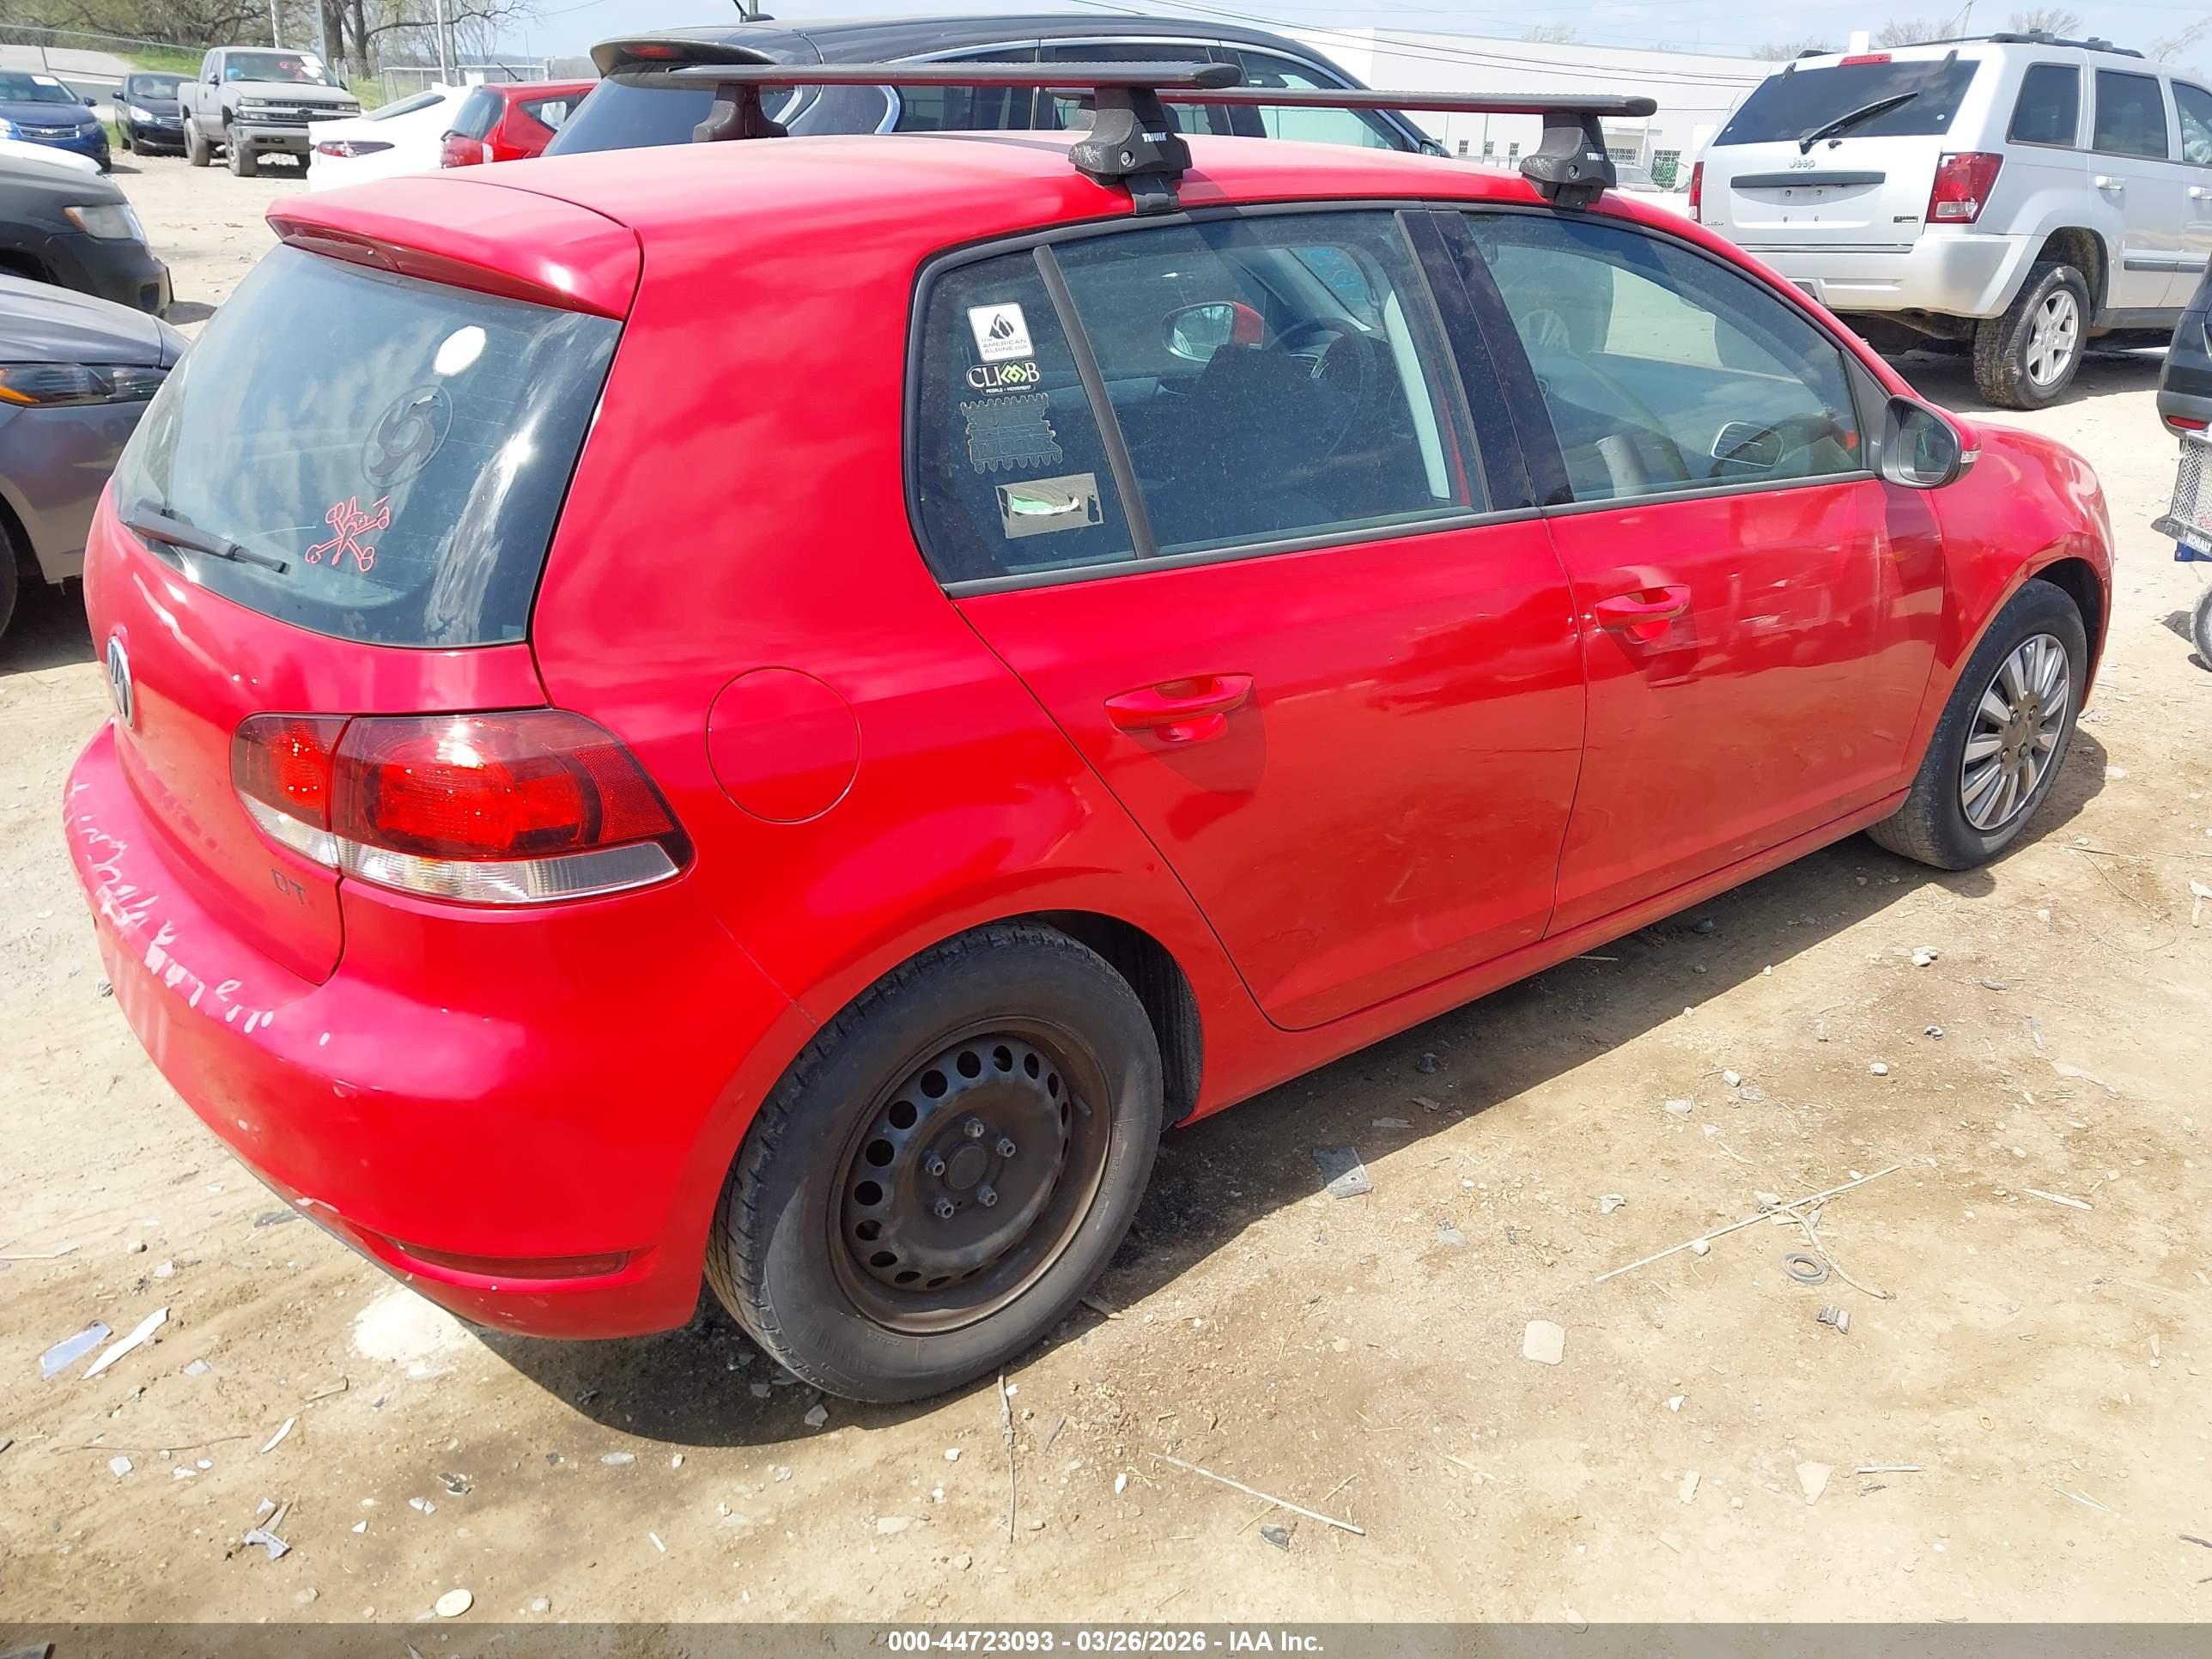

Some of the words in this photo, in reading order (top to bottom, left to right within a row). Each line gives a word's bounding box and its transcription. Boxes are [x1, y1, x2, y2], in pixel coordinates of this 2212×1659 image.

[1142, 131, 1167, 143] THULE
[1789, 157, 1816, 170] Jeep
[983, 338, 1027, 348] AMERICAN
[2186, 532, 2212, 553] KOBALT
